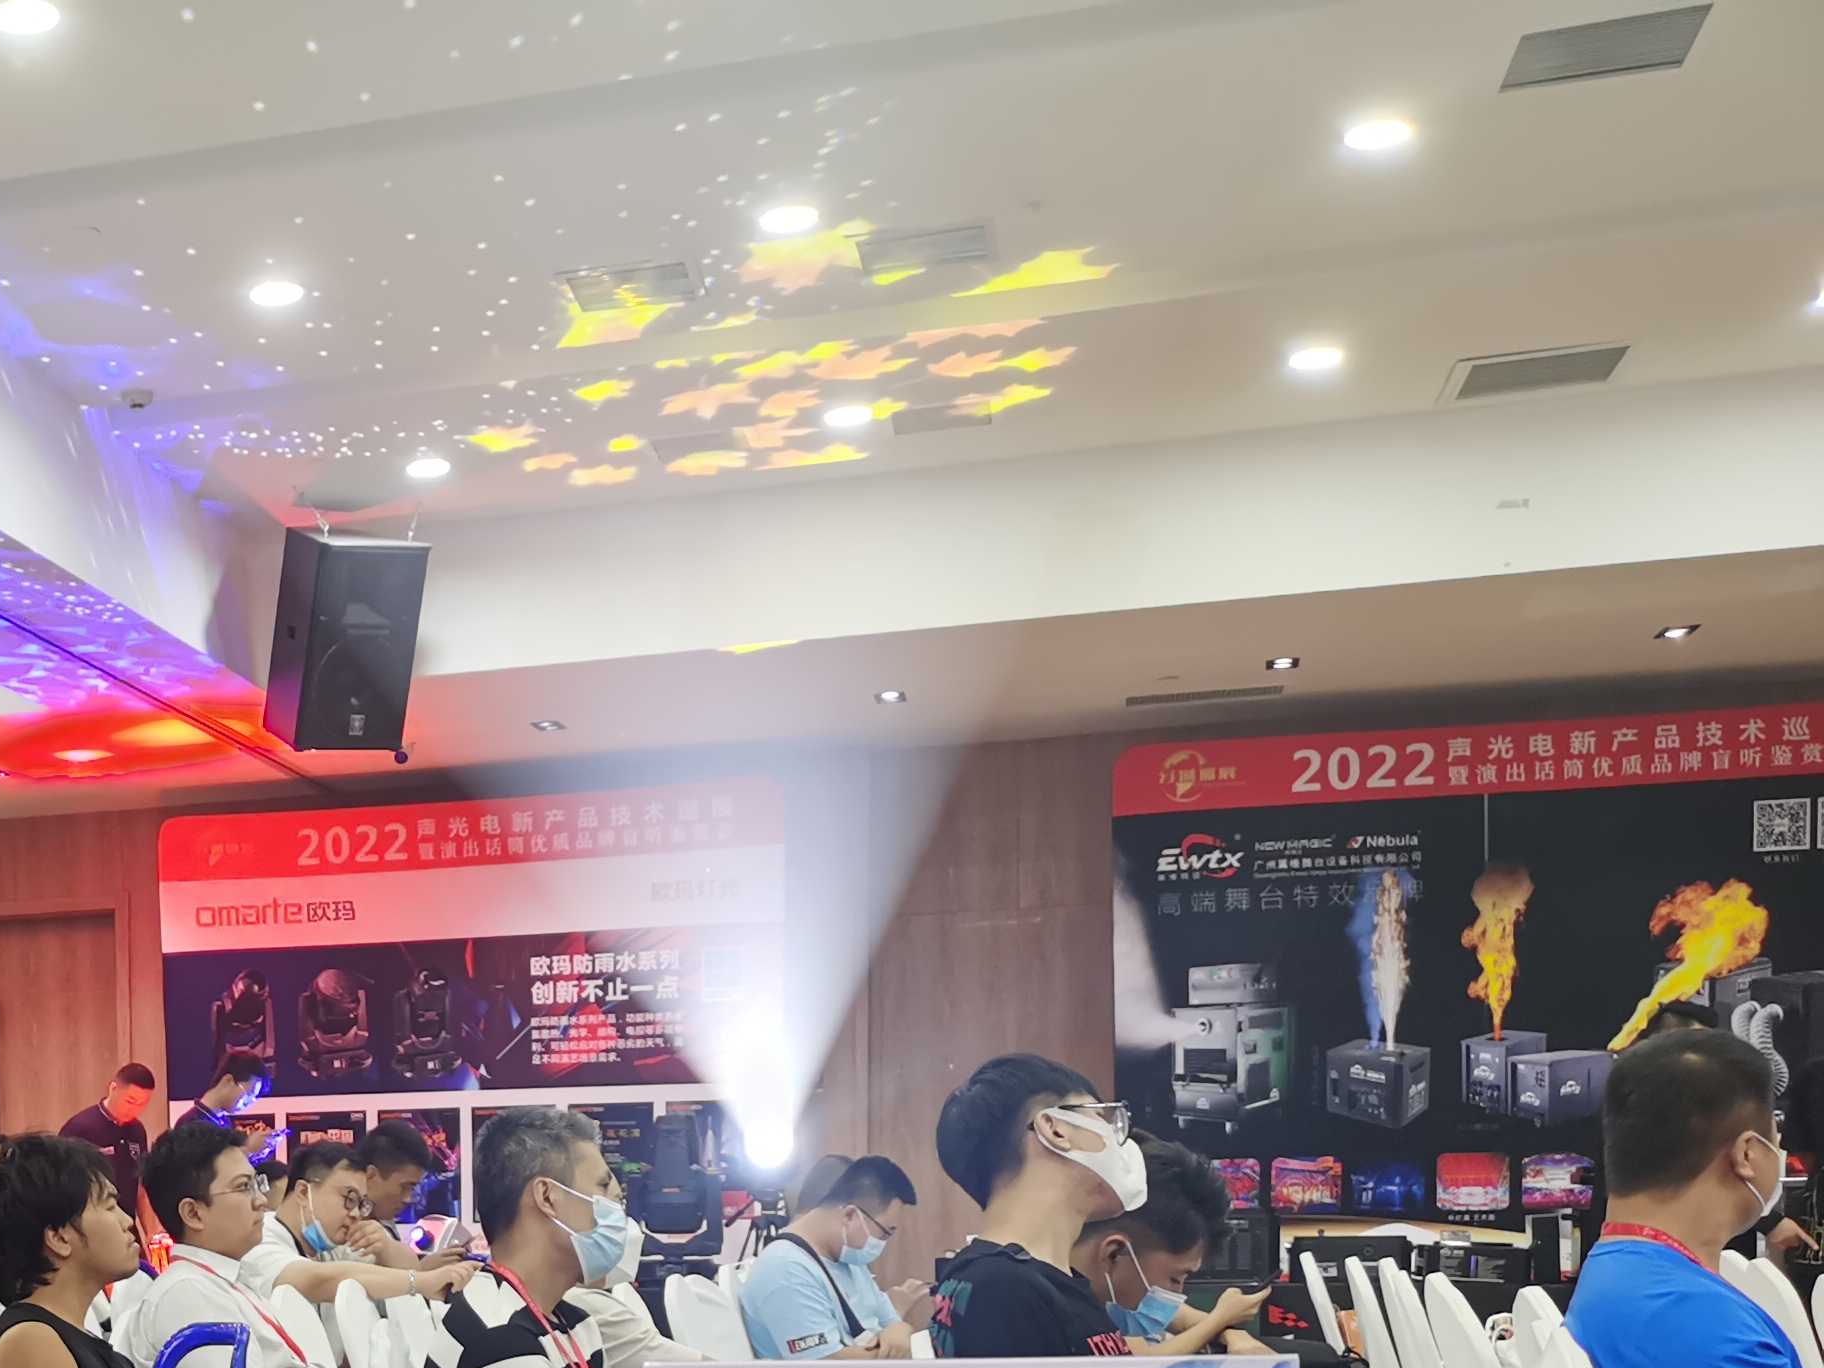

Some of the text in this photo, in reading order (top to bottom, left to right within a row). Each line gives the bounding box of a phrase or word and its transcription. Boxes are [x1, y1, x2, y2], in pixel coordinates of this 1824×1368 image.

[1291, 742, 1436, 793] 2022
[297, 823, 408, 866] 2022
[1366, 834, 1419, 848] Nebula
[306, 900, 356, 922] 欧玛
[530, 950, 680, 976] 欧玛防雨水系列
[530, 976, 680, 1005] 创新不止一点
